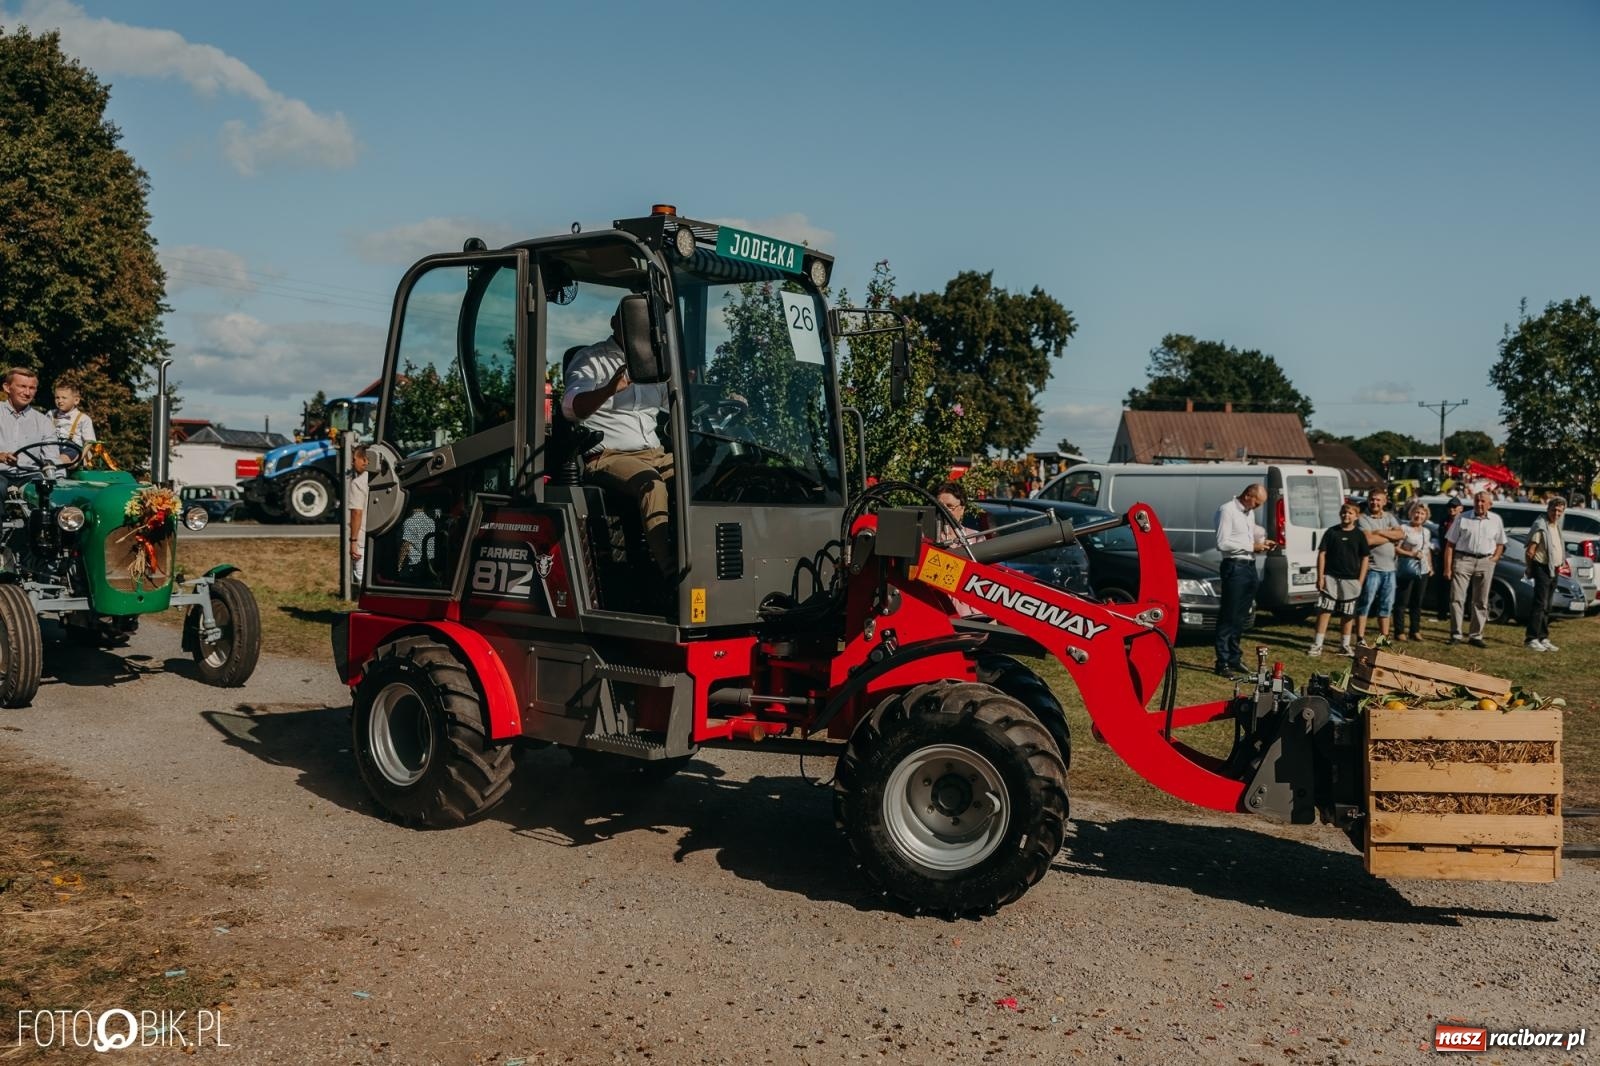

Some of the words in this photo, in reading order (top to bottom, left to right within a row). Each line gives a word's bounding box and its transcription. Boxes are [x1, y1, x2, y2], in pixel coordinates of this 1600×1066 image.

[730, 234, 795, 269] JODEŁKA
[789, 304, 814, 332] 26
[480, 546, 529, 561] FARMER
[472, 560, 534, 595] 812
[964, 574, 1108, 639] KINGWAY
